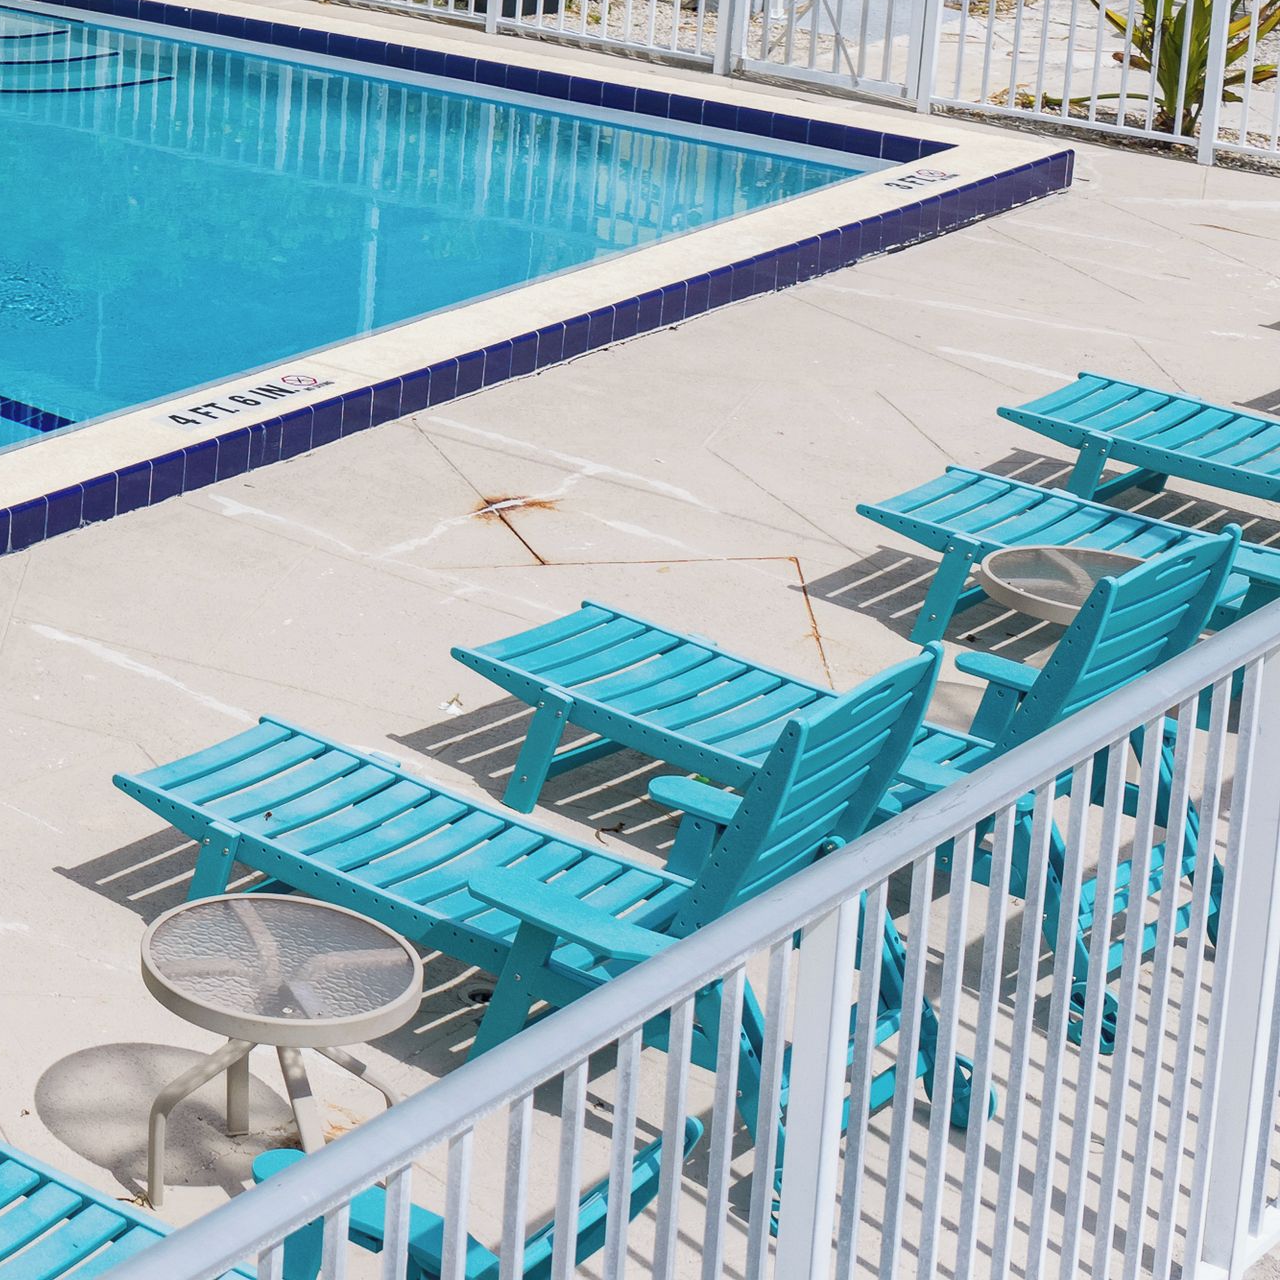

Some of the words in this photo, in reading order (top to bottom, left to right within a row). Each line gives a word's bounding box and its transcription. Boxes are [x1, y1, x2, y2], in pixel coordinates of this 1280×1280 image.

[168, 414, 202, 426] 4
[228, 395, 261, 406] 6
[248, 384, 300, 400] IN.
